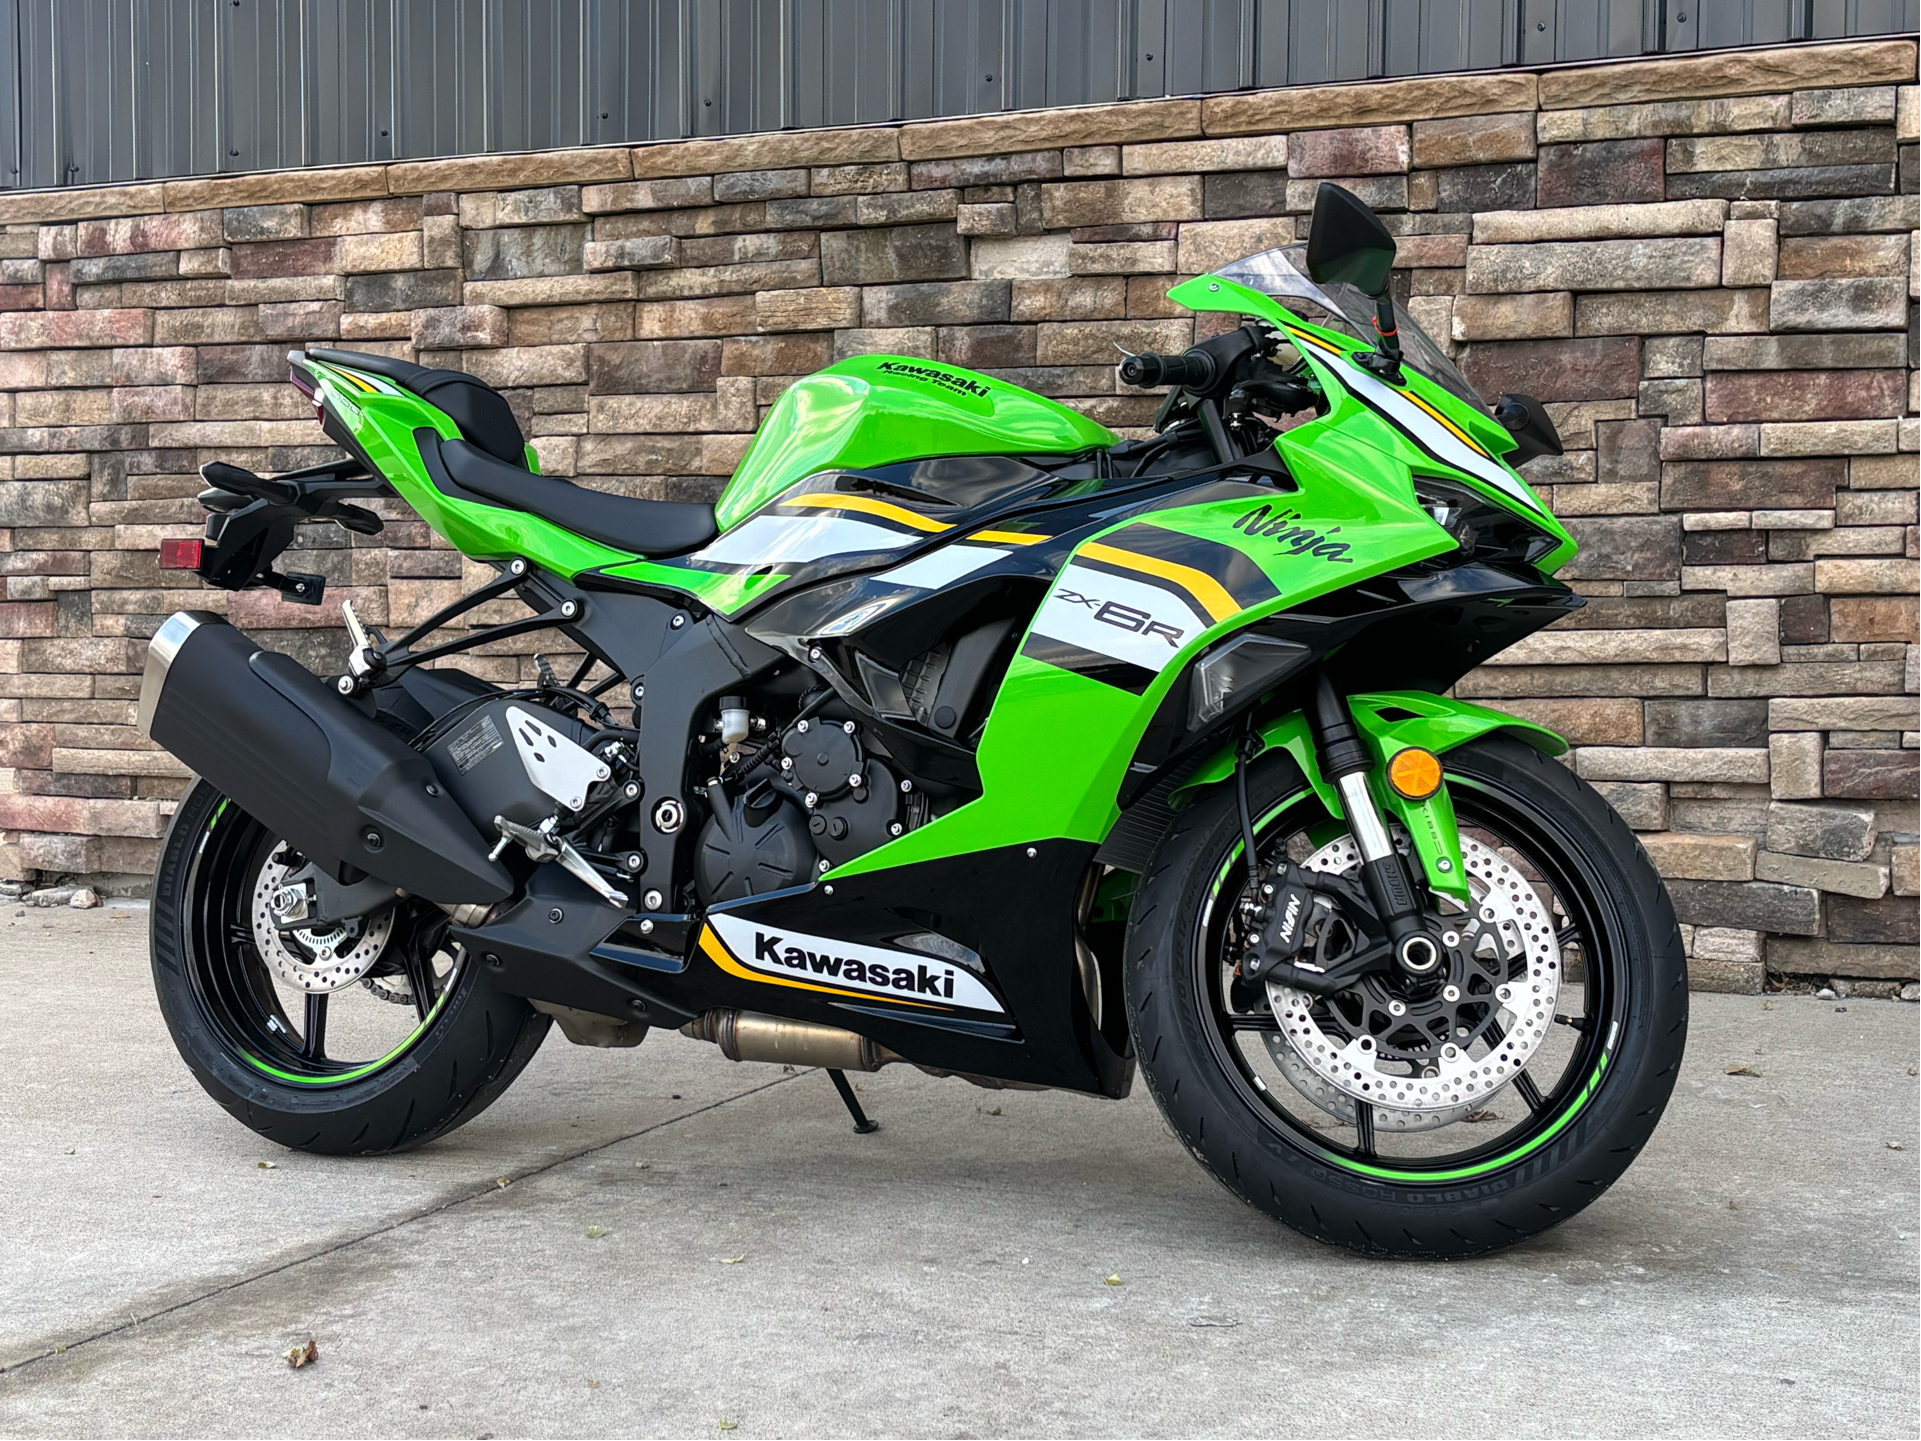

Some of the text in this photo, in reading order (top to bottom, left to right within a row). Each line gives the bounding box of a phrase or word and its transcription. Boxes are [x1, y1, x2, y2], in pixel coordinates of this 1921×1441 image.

[876, 361, 991, 398] Kawasaki
[883, 370, 968, 396] Racing Team
[1232, 504, 1354, 563] Ninja
[1053, 588, 1185, 648] ZX-6R
[161, 784, 210, 895] DIABLO ROS
[754, 931, 955, 999] Kawasaki
[1406, 1178, 1509, 1204] DIABLO
